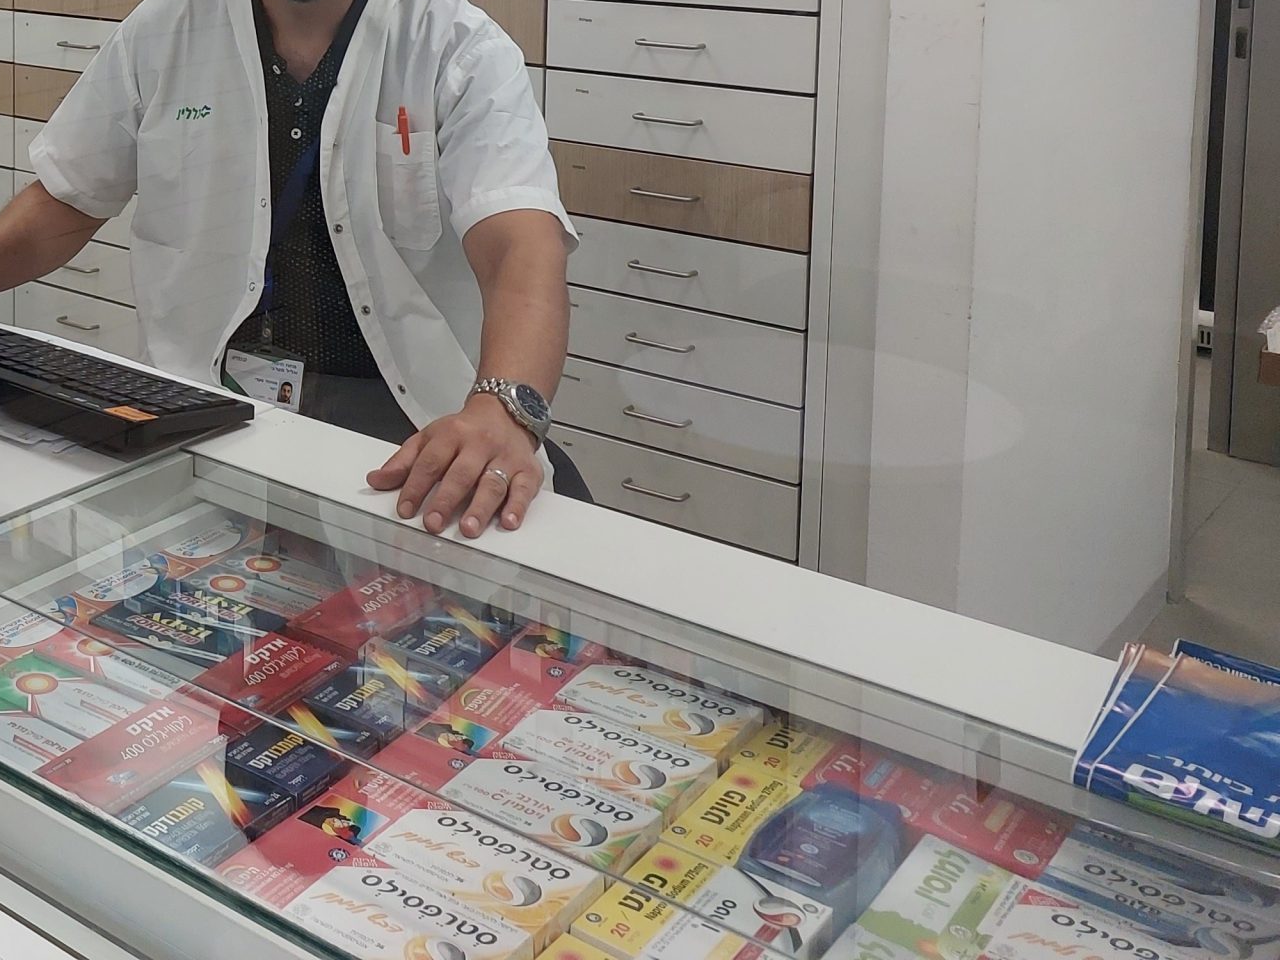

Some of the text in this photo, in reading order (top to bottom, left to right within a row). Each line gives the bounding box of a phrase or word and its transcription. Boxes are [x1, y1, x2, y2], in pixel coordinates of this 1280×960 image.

[360, 573, 397, 595] אדקס
[361, 601, 377, 614] 400
[127, 615, 171, 637] FORTE
[145, 611, 213, 639] Advil
[245, 638, 289, 664] אדקס
[246, 672, 267, 687] 400
[335, 679, 386, 711] קומבודקס
[126, 706, 175, 736] אדקס
[121, 743, 144, 762] 400
[248, 733, 304, 770] קומבודקס
[764, 757, 780, 768] 20
[1165, 756, 1253, 795] ביותר
[142, 797, 205, 839] קומבודקס
[503, 799, 544, 819] ויטמין
[700, 789, 747, 826] פוינט
[696, 834, 714, 848] 20
[915, 850, 970, 907] למוסין
[618, 871, 669, 912] פוינט
[370, 912, 404, 933] דבש
[609, 922, 631, 939] 20
